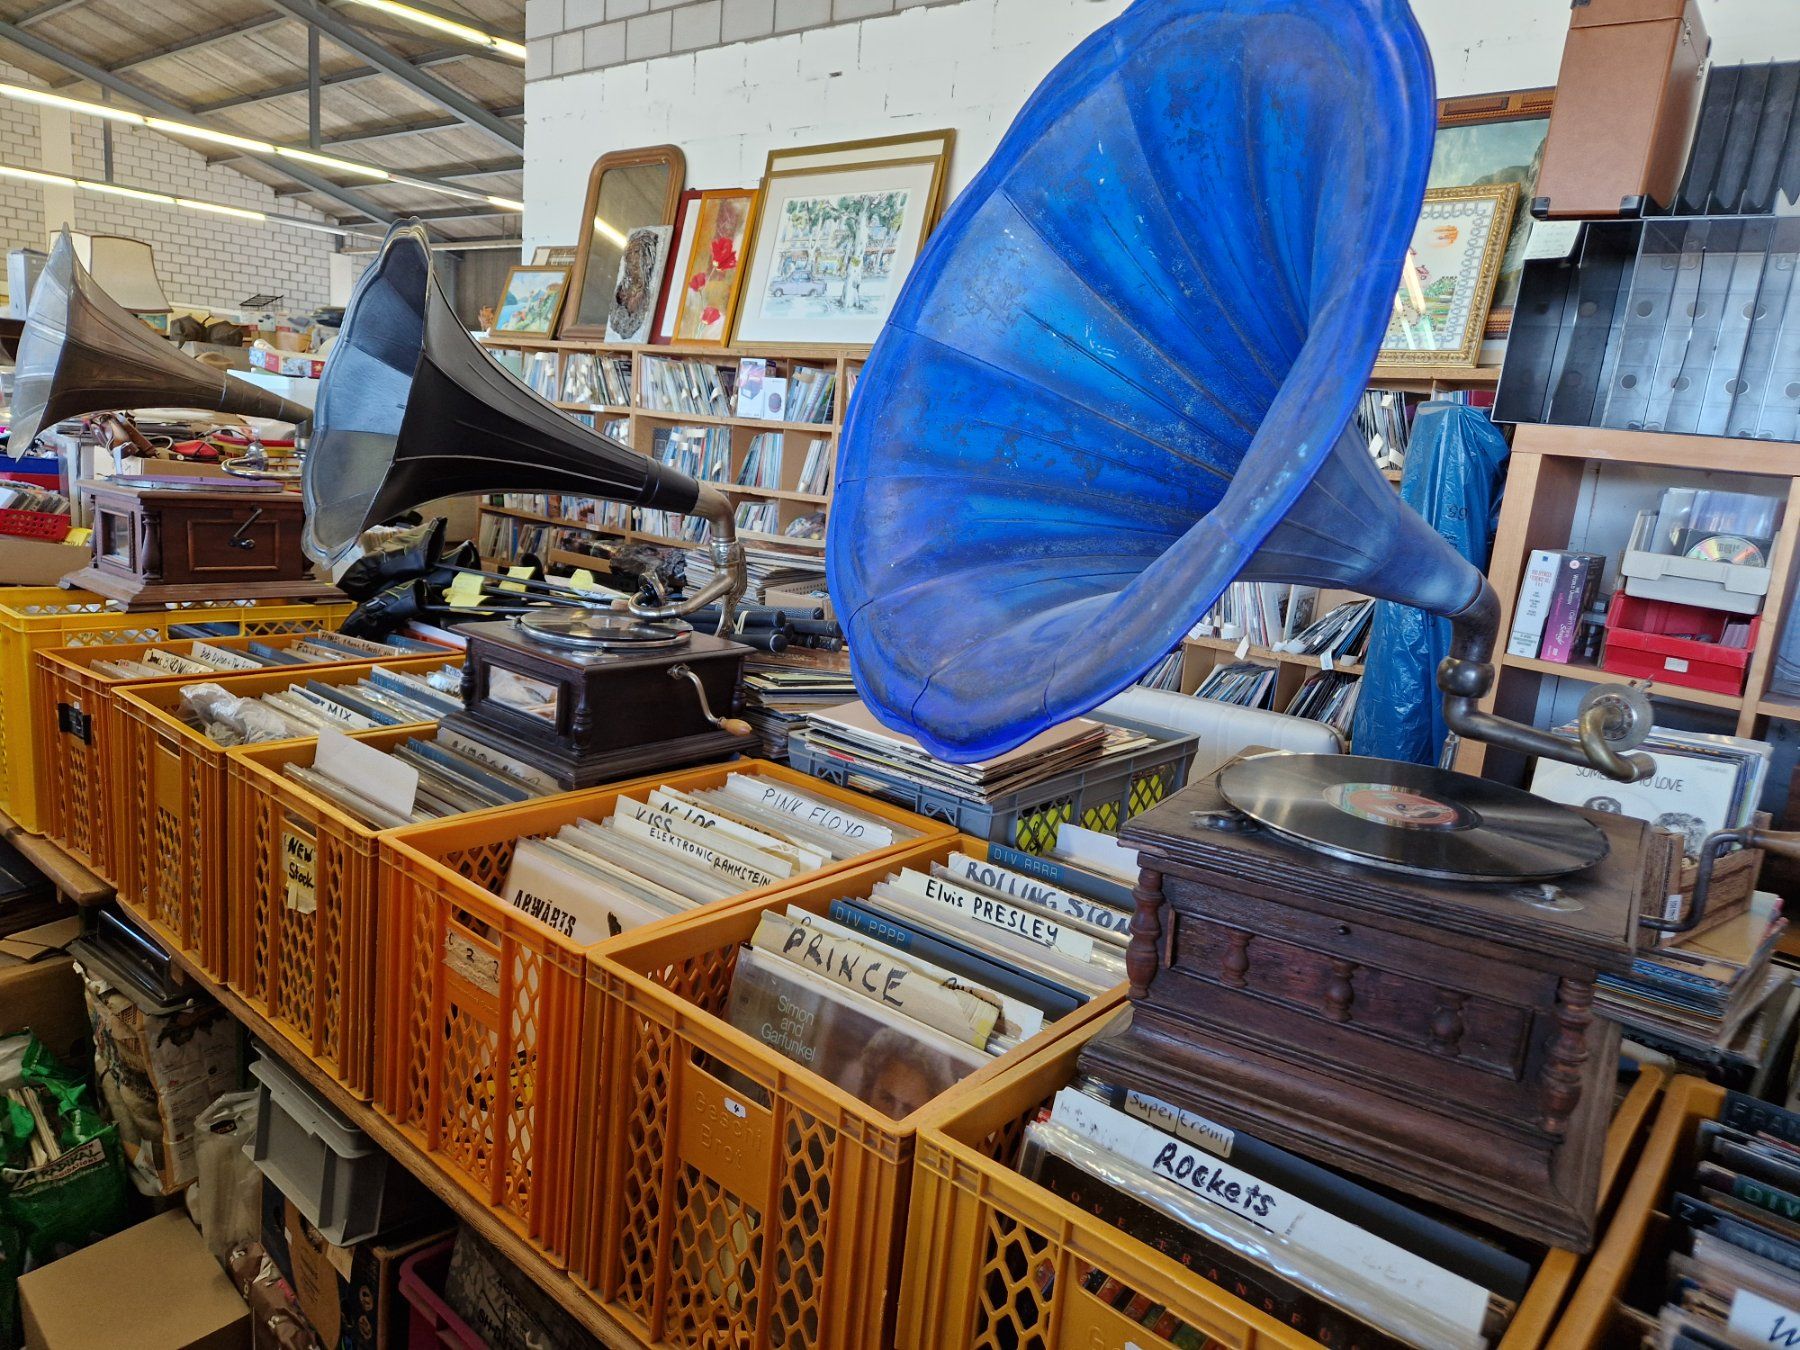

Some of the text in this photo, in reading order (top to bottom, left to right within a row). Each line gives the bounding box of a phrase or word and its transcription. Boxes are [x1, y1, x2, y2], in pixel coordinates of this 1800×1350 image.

[327, 703, 352, 721] MIX
[1655, 776, 1684, 792] LOVE
[763, 788, 803, 813] PINK
[809, 807, 865, 838] FLOYD
[287, 838, 313, 862] NEW
[649, 827, 714, 863] ELEKTRONIC
[993, 846, 1018, 865] DIV
[288, 861, 315, 888] Stock
[926, 879, 1060, 945] Elvis PRESLEY
[965, 861, 1132, 933] ROLLING STON
[782, 926, 908, 1007] PRINCE
[777, 995, 815, 1026] Simon
[761, 1022, 816, 1062] Garfunkel
[781, 1017, 804, 1037] and
